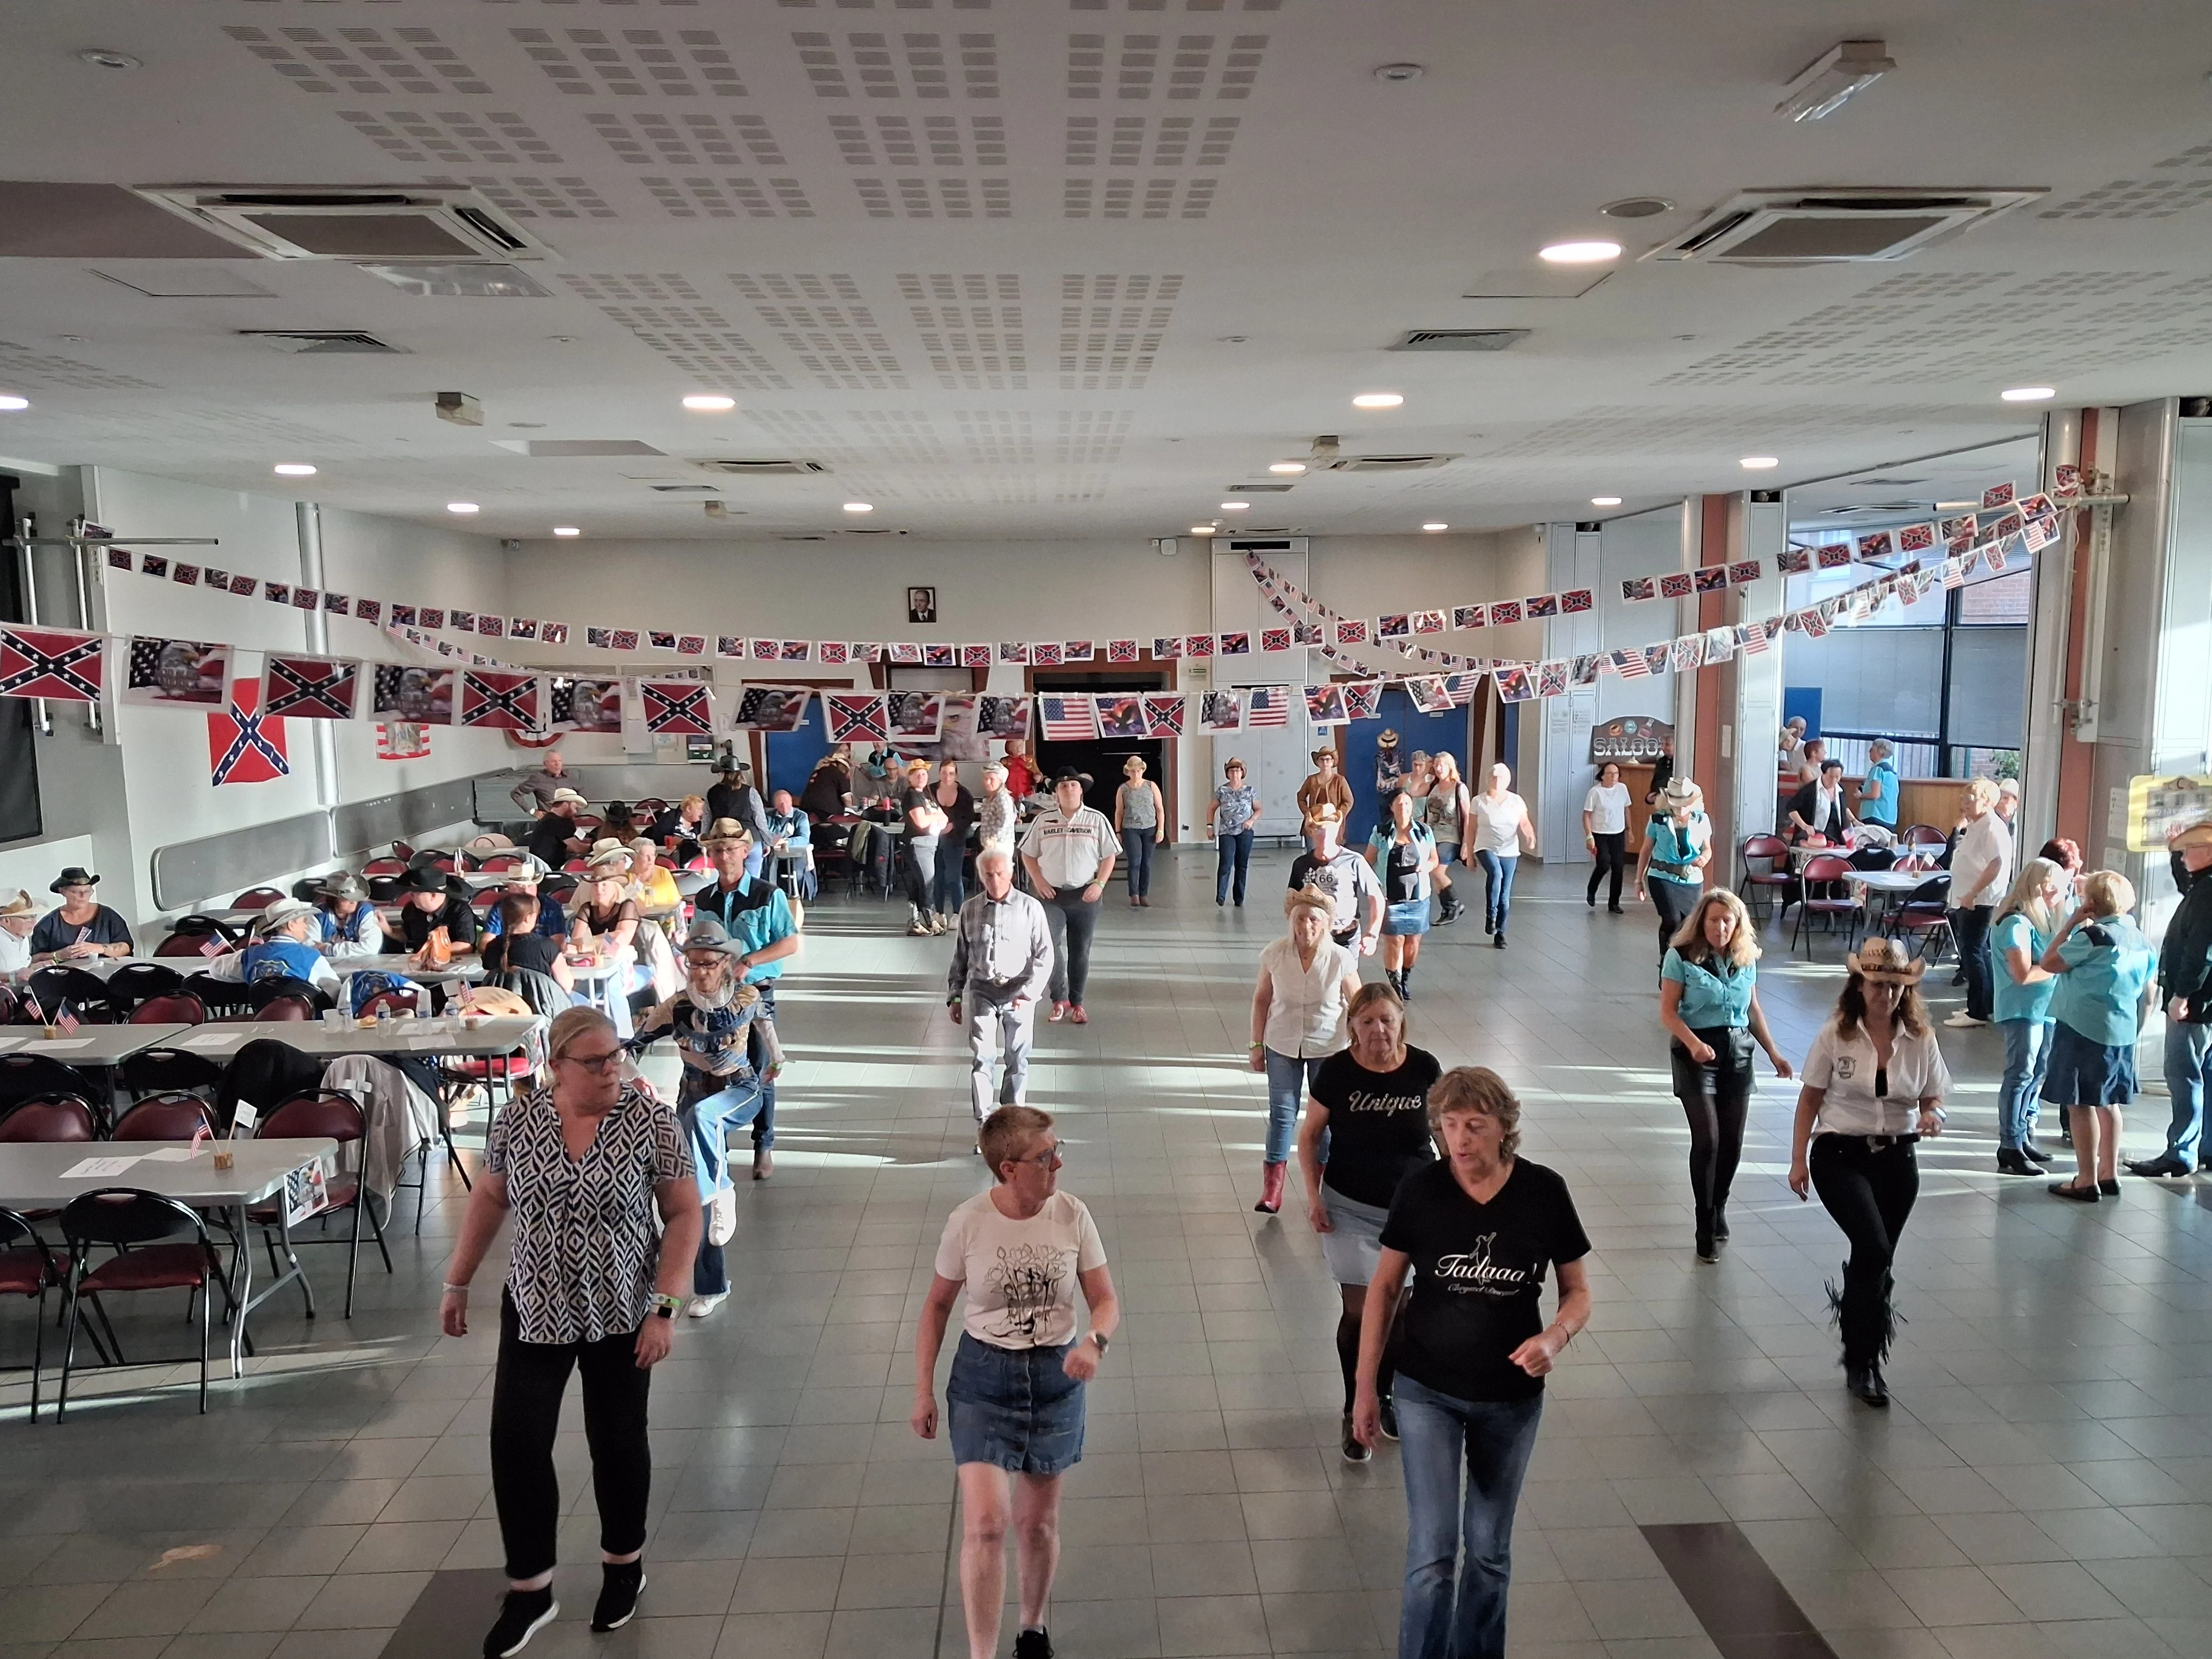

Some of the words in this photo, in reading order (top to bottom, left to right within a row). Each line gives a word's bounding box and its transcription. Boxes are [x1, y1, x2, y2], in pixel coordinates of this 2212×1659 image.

[1319, 874, 1333, 883] 66
[1349, 1090, 1422, 1117] Unique
[1435, 1254, 1526, 1282] Tadaaa
